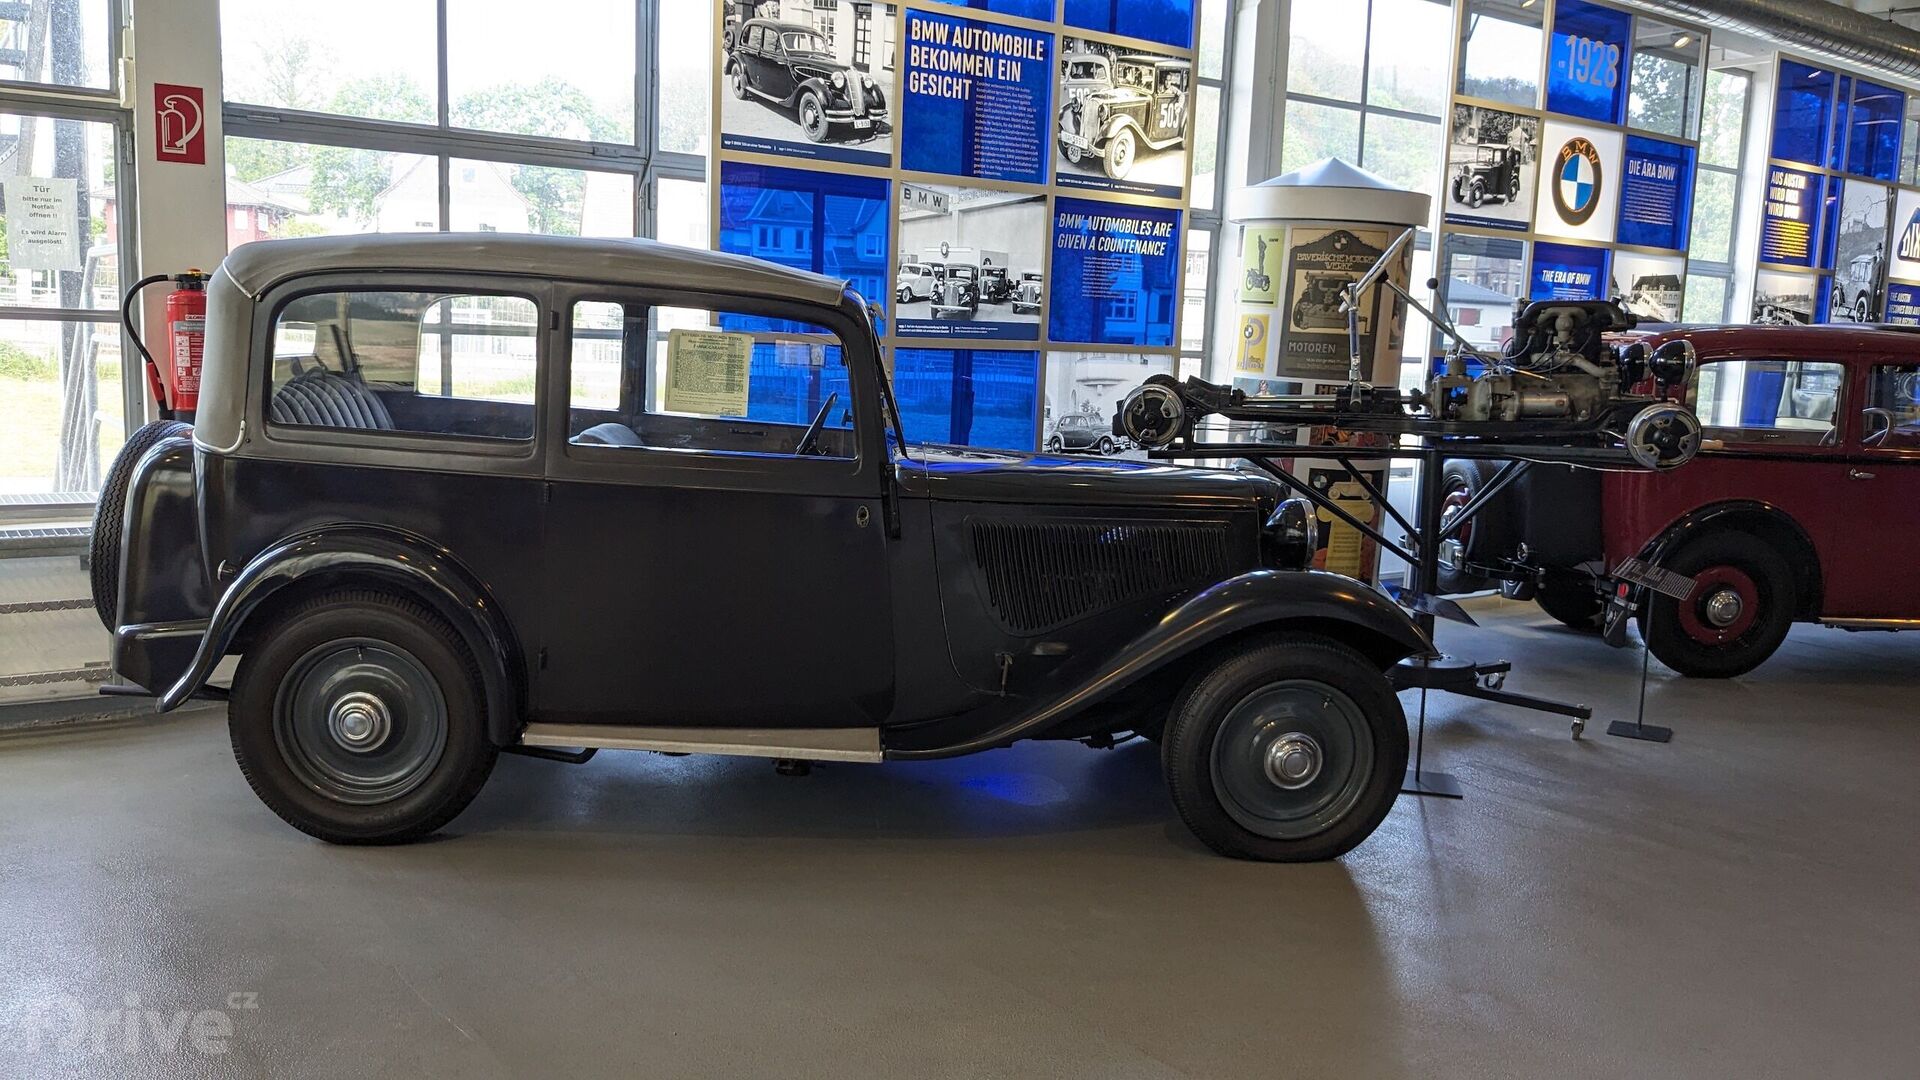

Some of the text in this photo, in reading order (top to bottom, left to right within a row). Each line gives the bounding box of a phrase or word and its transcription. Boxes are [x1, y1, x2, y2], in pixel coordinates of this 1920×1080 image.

[912, 19, 1045, 61] BMW AUTOMOBILE
[910, 44, 1021, 82] BEKOMMEN EIN
[1565, 35, 1619, 88] 1928
[909, 71, 972, 100] GESICHT
[1562, 140, 1599, 164] BMW
[1628, 159, 1641, 176] DIE
[1657, 164, 1676, 181] BMW
[33, 185, 51, 193] Tür
[904, 187, 942, 208] BMW
[1058, 213, 1173, 237] BMW AUTOMOBILES ARE
[1058, 233, 1167, 256] GIVEN A COUNTENANCE
[1542, 269, 1554, 283] THE
[1554, 270, 1567, 283] ERA
[1567, 272, 1576, 284] OF
[1289, 341, 1336, 353] MOTOREN
